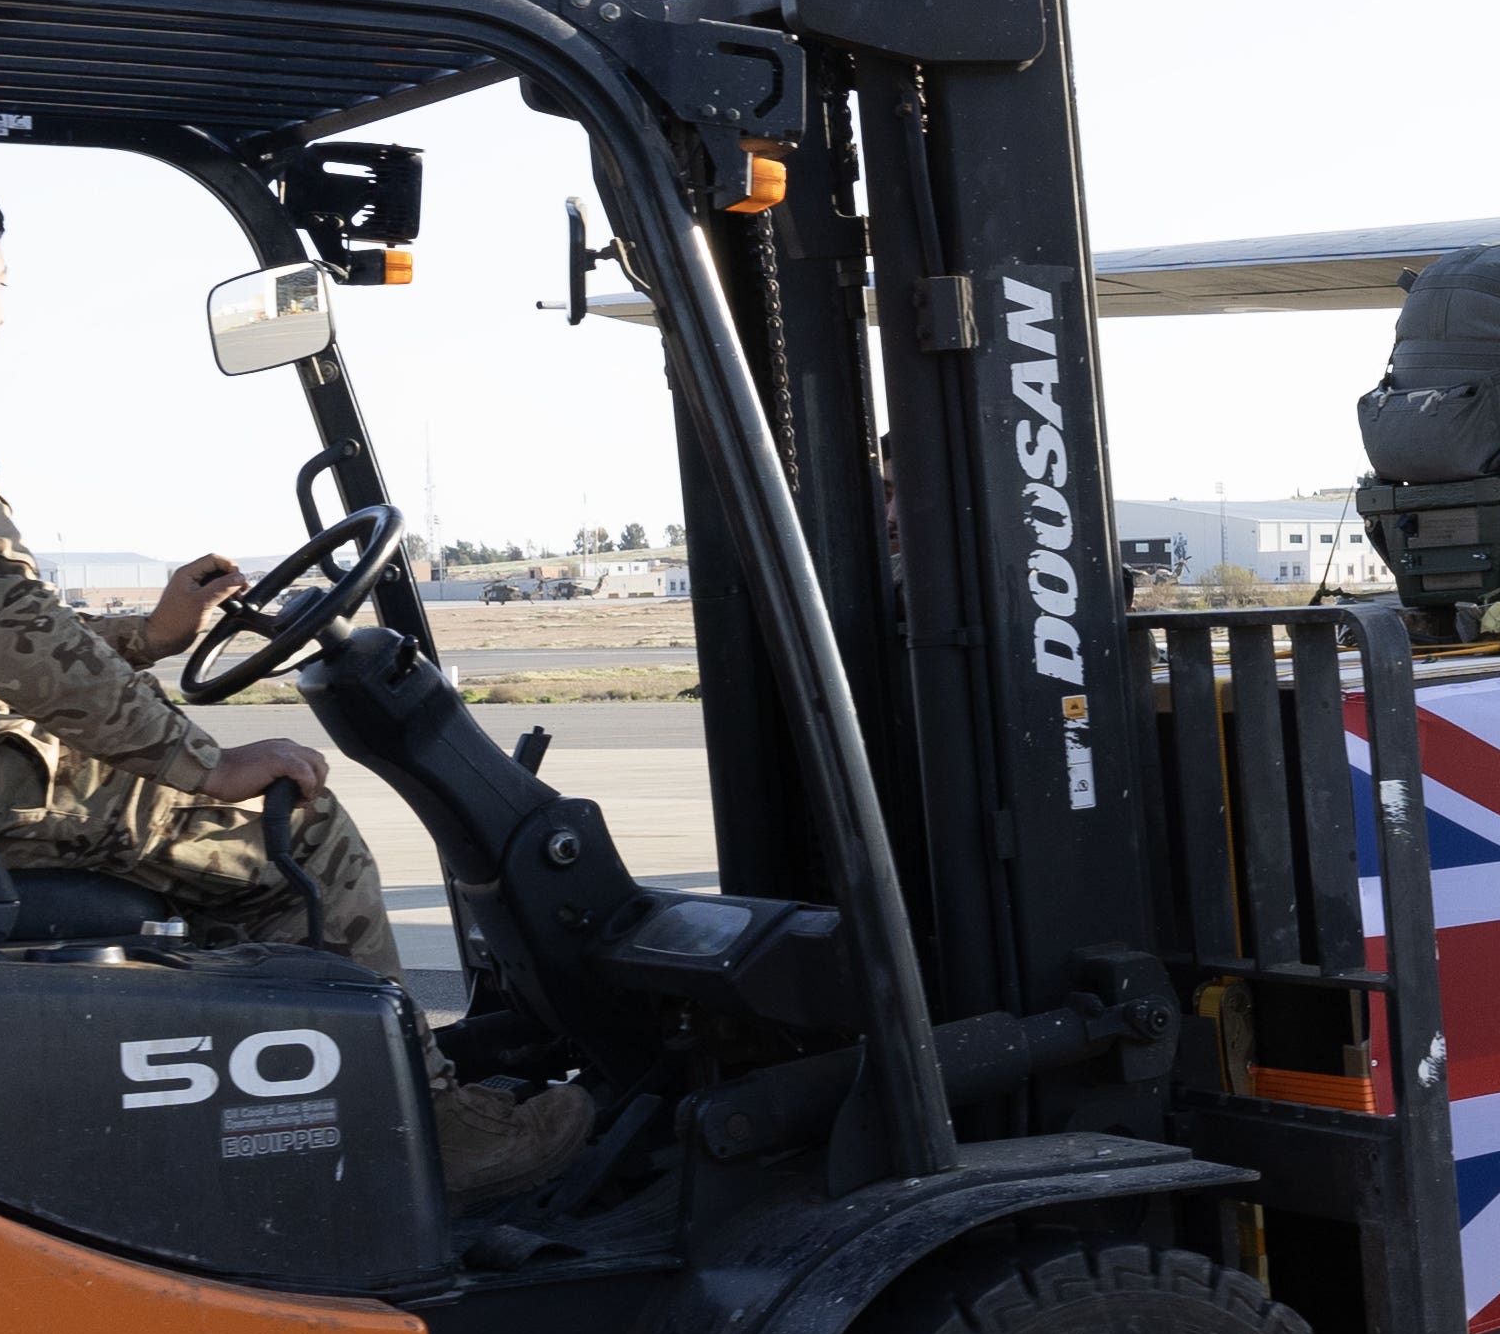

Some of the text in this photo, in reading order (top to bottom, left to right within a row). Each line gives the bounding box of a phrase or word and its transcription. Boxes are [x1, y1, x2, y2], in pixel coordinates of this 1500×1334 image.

[1001, 275, 1085, 687] DOOSAN
[121, 1029, 340, 1109] 50
[221, 1126, 341, 1158] EQUIPPED
